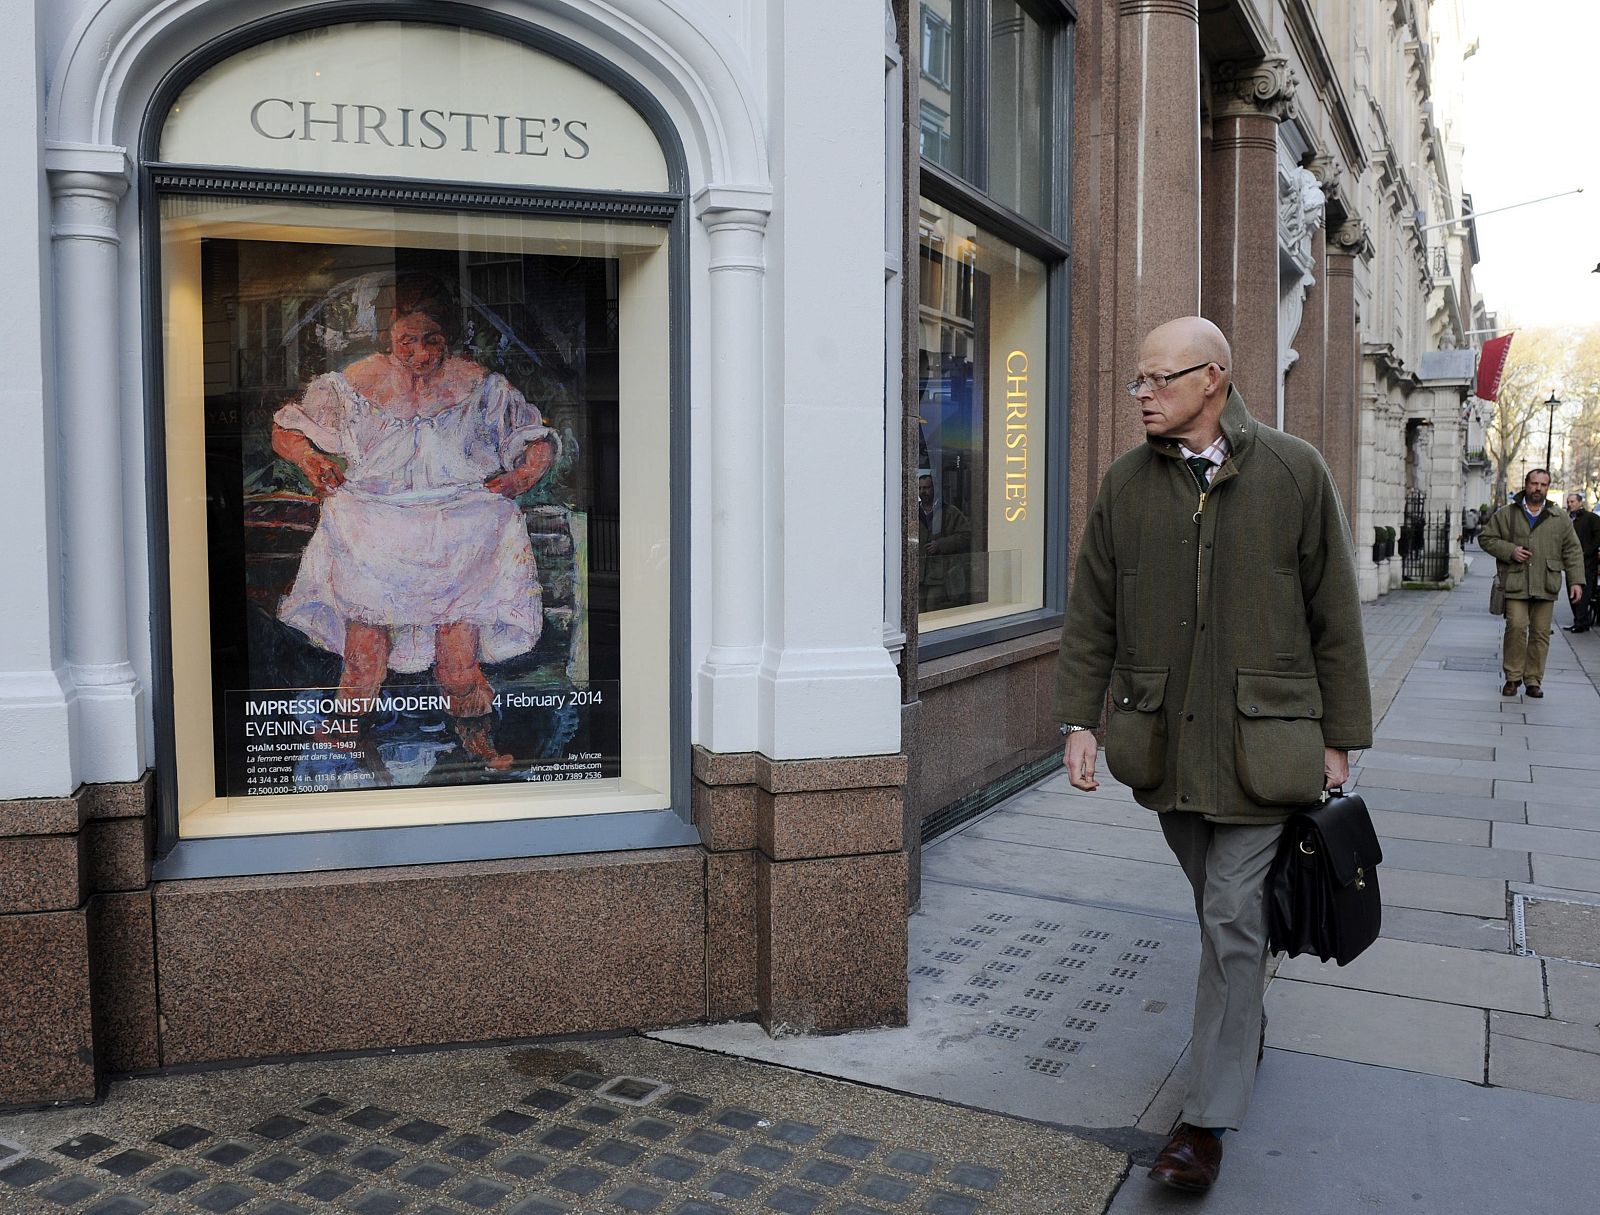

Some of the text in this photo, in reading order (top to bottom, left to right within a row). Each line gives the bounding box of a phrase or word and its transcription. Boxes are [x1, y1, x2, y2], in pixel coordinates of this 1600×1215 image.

[250, 97, 590, 160] CHRISTIE'S
[1005, 350, 1029, 522] CHRISTIE'S
[245, 695, 451, 716] IMPRESSIONIST/MODERN
[491, 690, 603, 710] 4 February 2014
[245, 718, 359, 737] EVENING SALE
[275, 742, 311, 752] SOUTINE
[246, 755, 255, 763] La
[257, 754, 283, 762] femme
[284, 753, 309, 761] entrant
[310, 751, 328, 760] dans
[350, 751, 365, 759] 1931
[568, 751, 602, 761] Jay Vincze
[246, 765, 256, 773] oil
[268, 765, 293, 773] canvas
[530, 762, 602, 773] jvincze@christies.com
[247, 776, 258, 784] 44
[260, 776, 271, 784] 3/4
[279, 775, 289, 783] 28
[292, 775, 303, 783] 1/4
[304, 774, 313, 782] in.
[527, 771, 602, 782] +44 (0) 20 7389 2536
